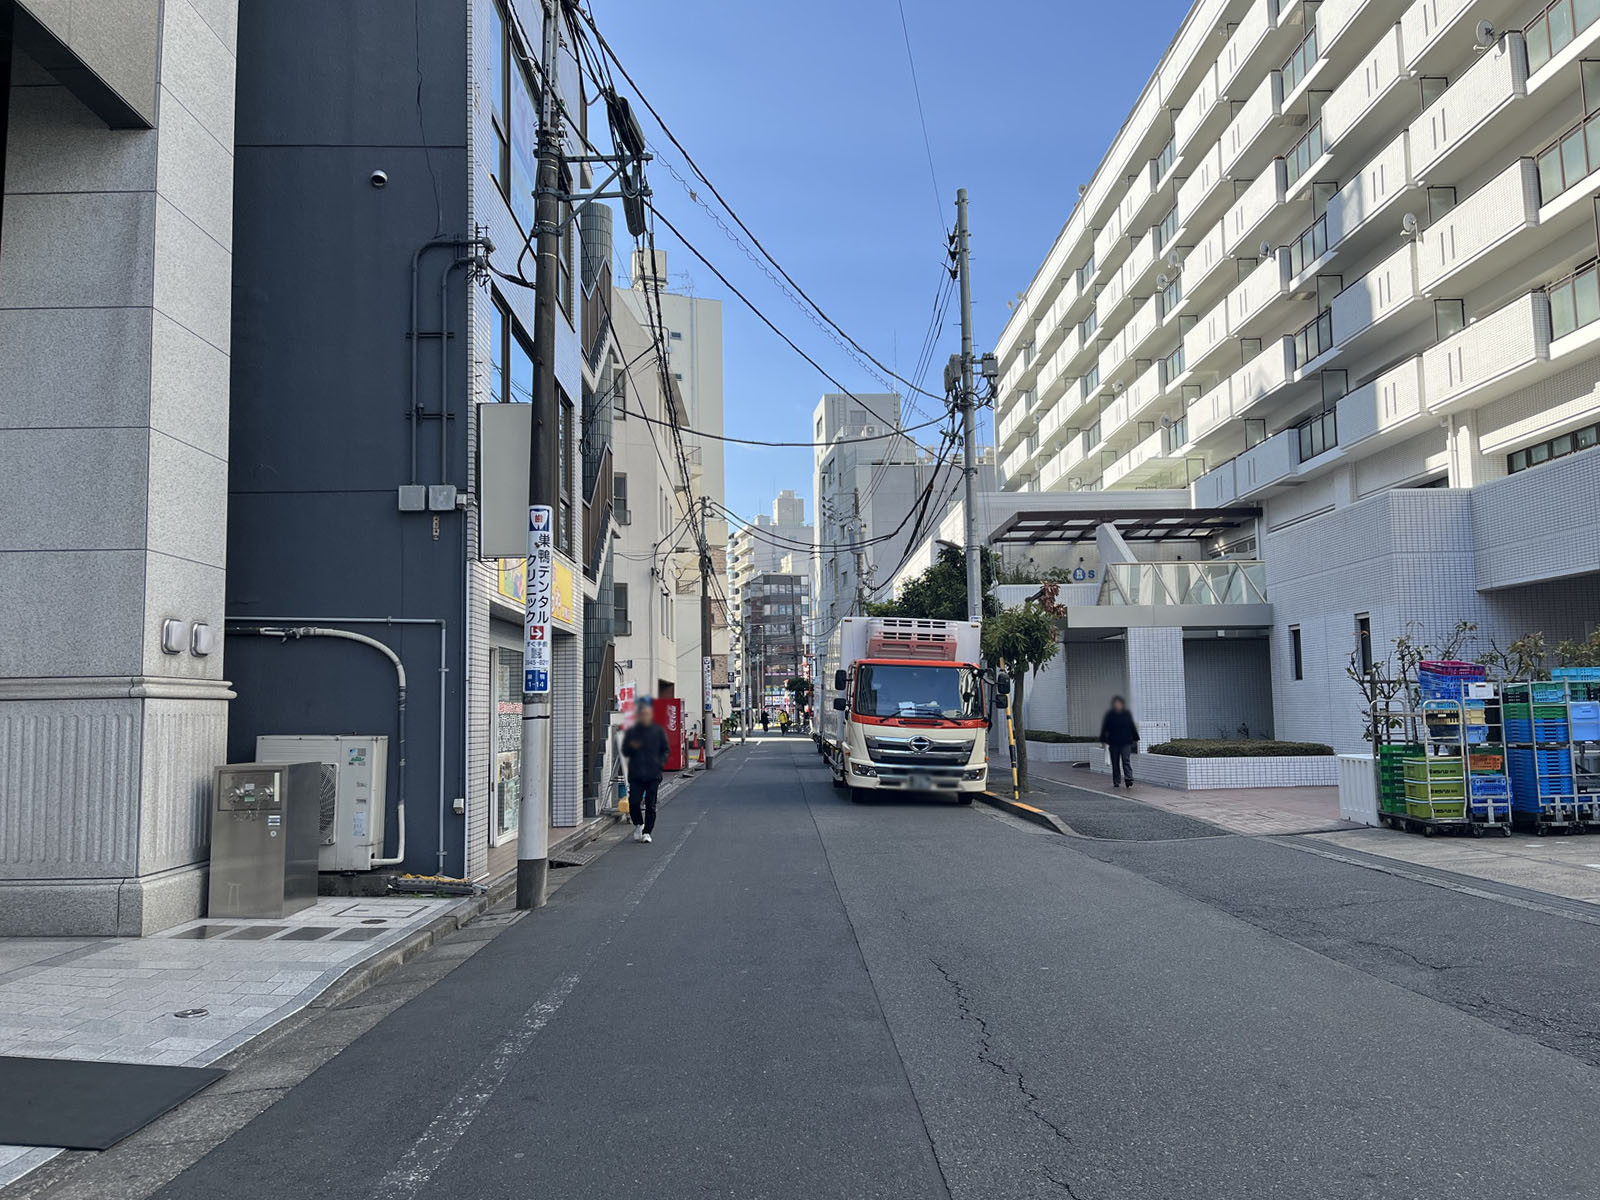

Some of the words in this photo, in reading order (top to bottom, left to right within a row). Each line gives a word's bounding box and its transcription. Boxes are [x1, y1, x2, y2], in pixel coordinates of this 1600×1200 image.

[526, 554, 537, 624] クリニック
[537, 533, 550, 624] 巣鴨デンタル
